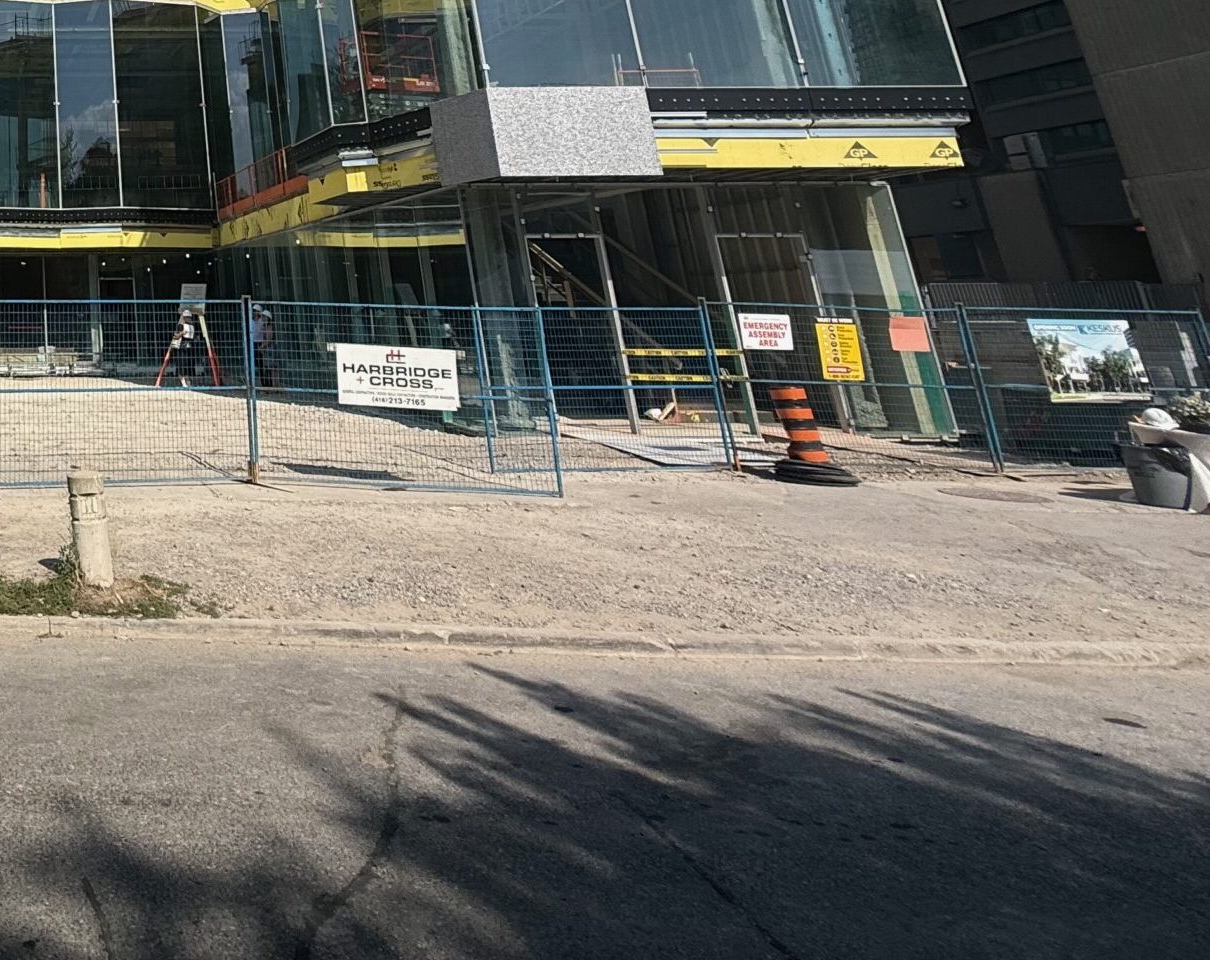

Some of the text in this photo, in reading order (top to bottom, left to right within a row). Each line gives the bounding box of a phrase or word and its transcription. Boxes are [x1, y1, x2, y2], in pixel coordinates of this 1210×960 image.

[850, 148, 868, 157] GP
[935, 148, 954, 157] GP
[743, 322, 788, 330] EMERGENCY
[748, 331, 786, 339] ASSEMBLY
[759, 339, 779, 347] AREA
[342, 363, 452, 379] HARBRIDGE
[369, 376, 434, 390] CROSS
